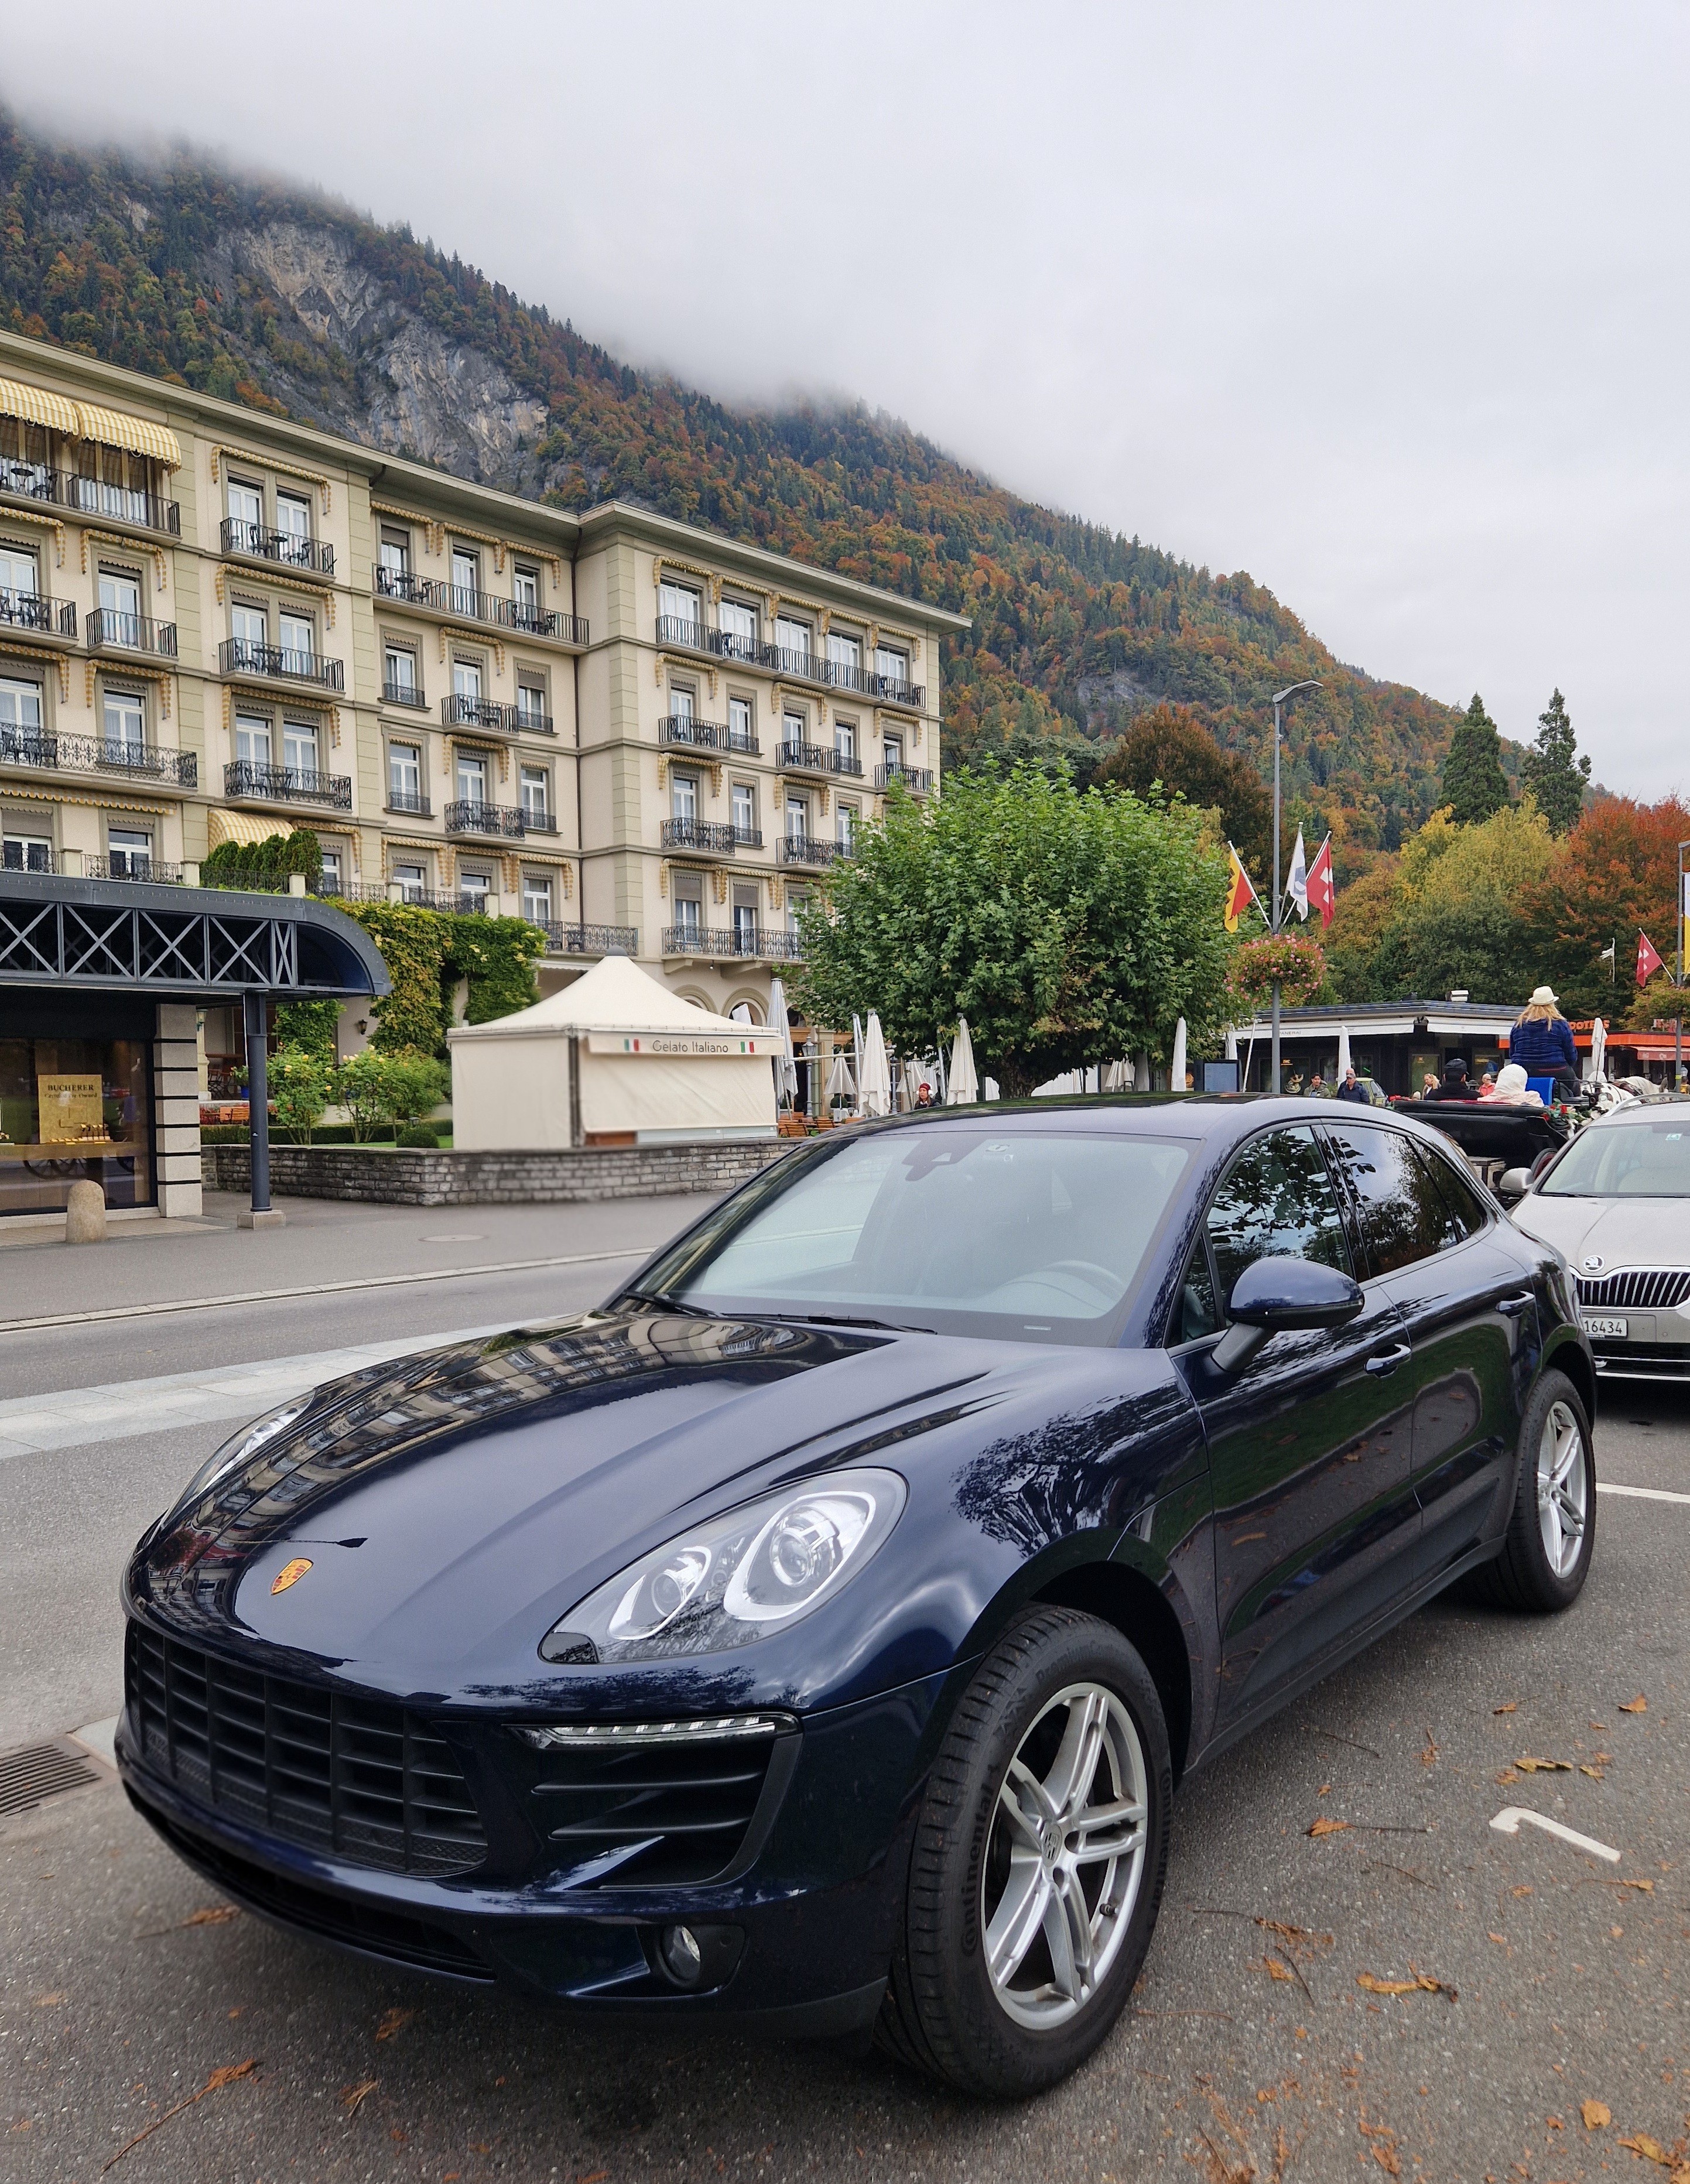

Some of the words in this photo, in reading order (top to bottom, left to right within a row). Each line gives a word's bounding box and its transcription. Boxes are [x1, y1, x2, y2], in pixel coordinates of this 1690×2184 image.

[1568, 1019, 1610, 1030] OOTES
[652, 1040, 688, 1052] Gelato
[692, 1041, 728, 1053] Italiano
[1584, 1320, 1623, 1334] 16434
